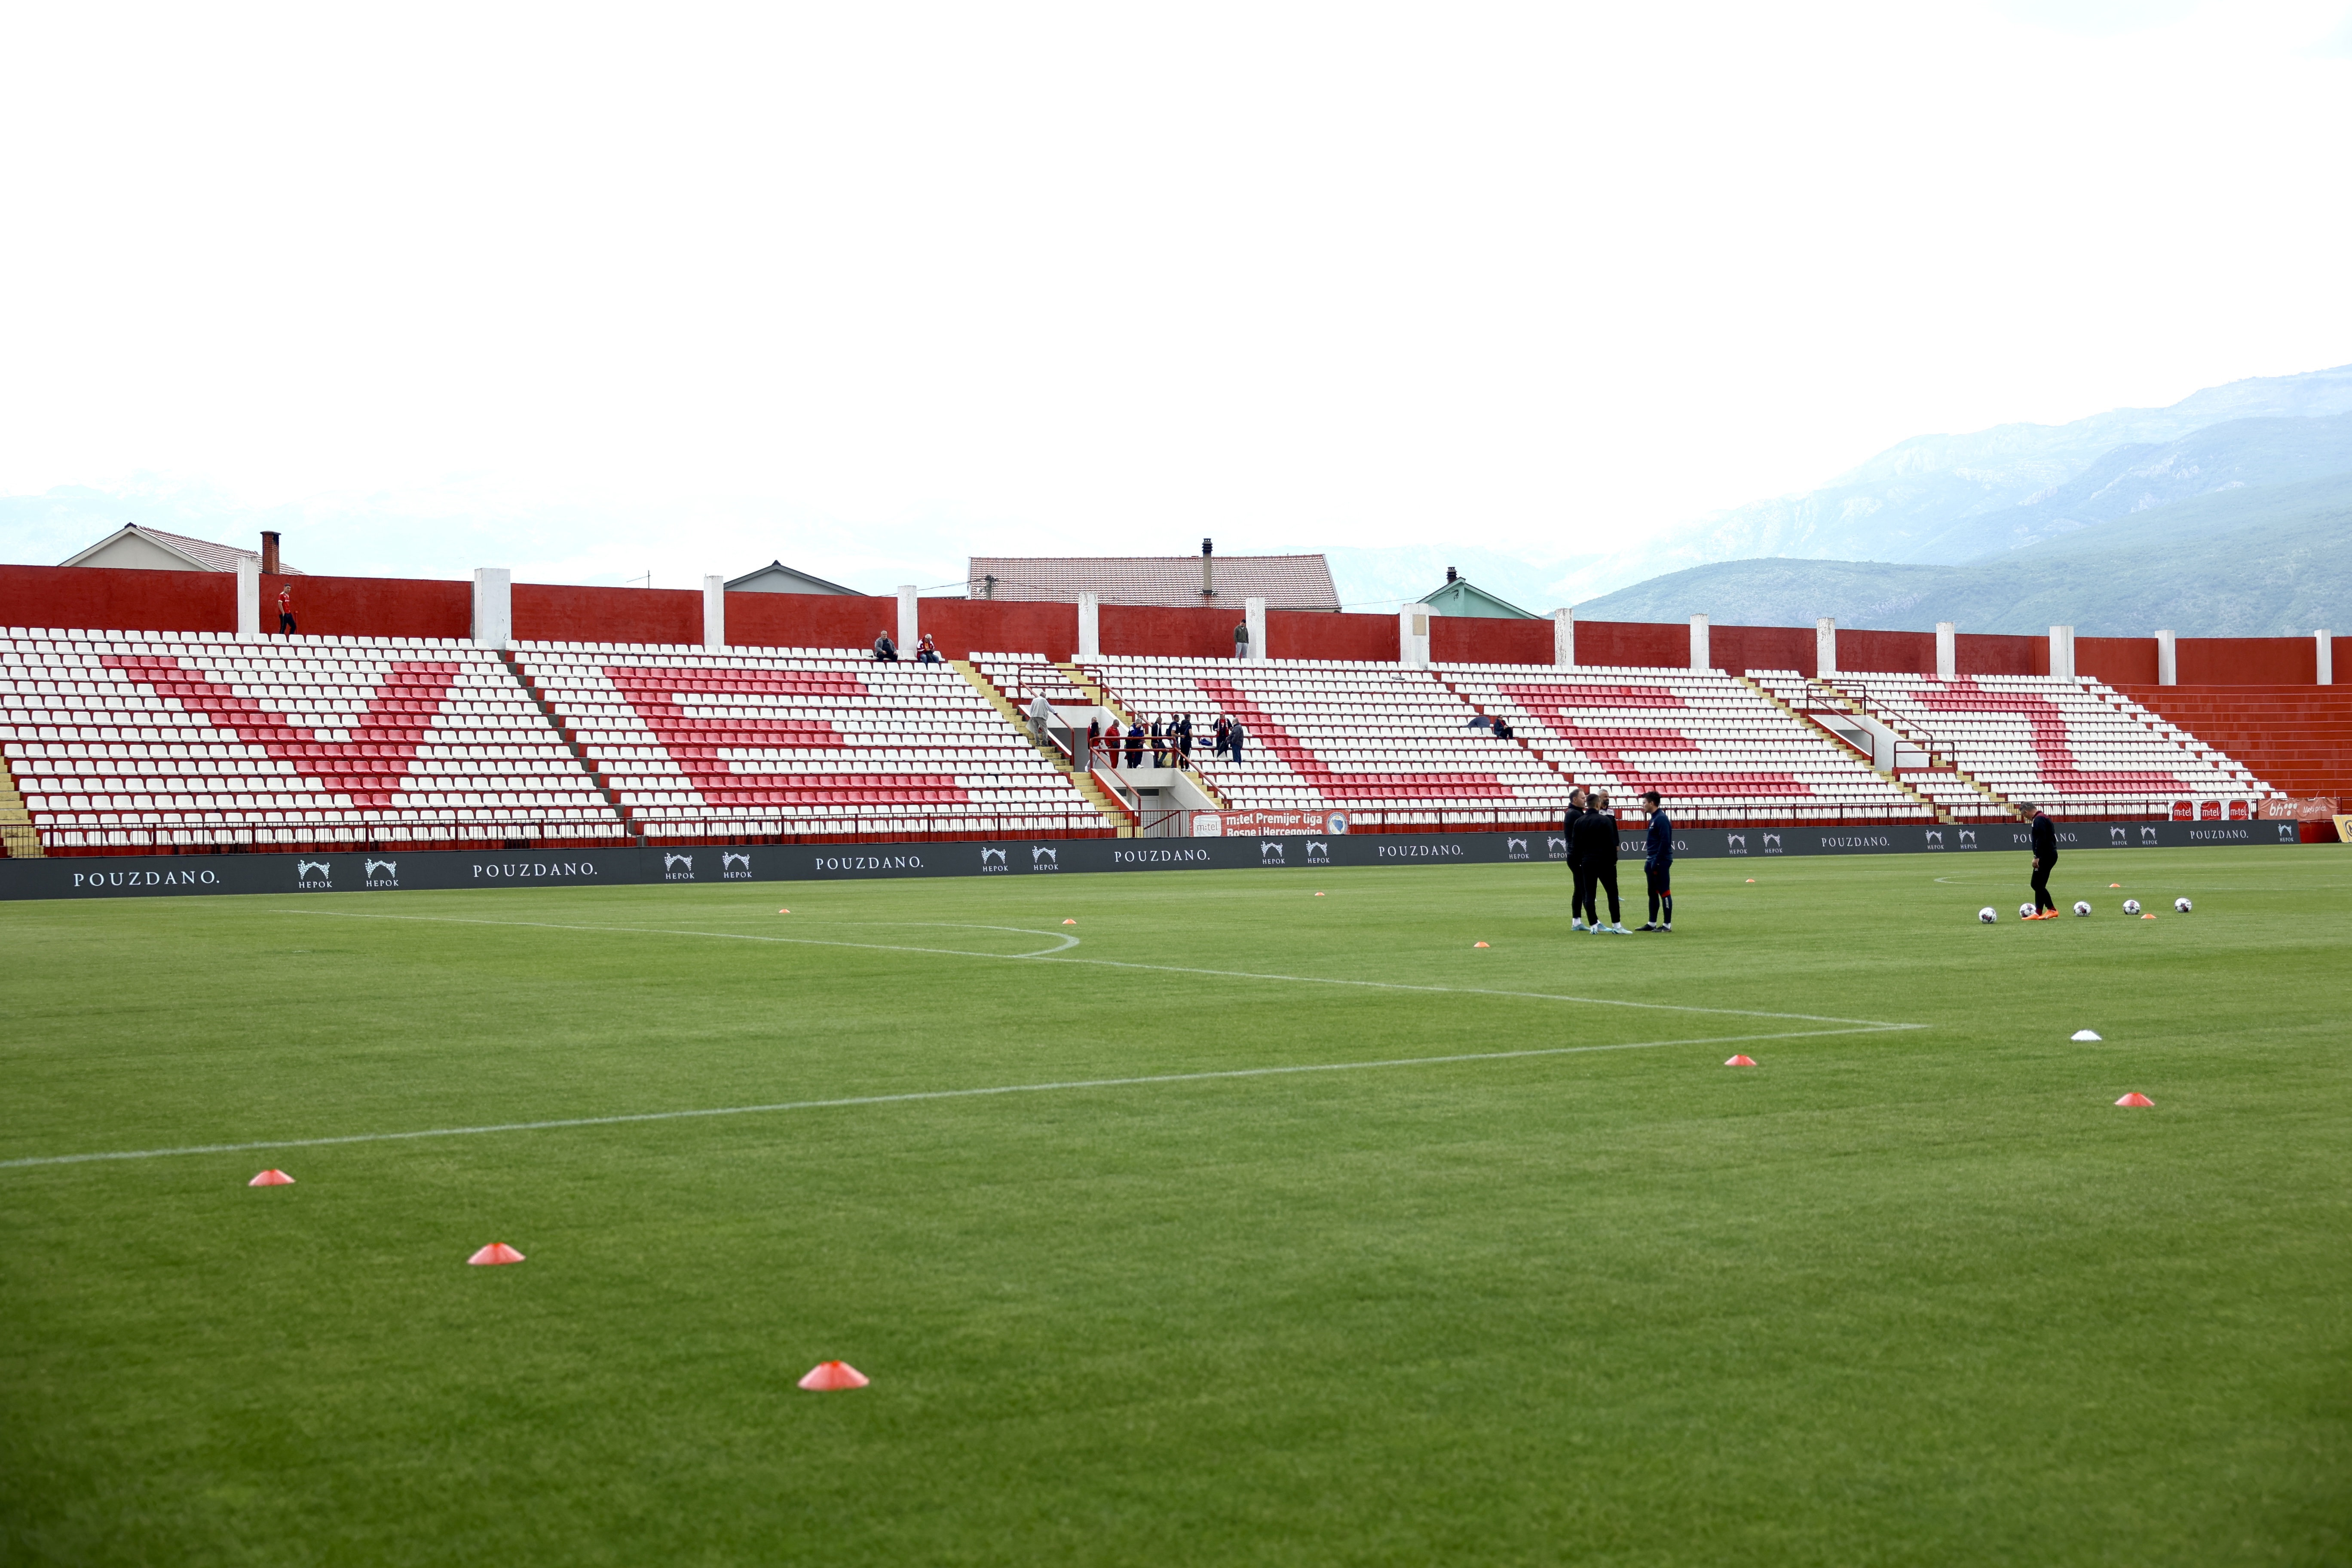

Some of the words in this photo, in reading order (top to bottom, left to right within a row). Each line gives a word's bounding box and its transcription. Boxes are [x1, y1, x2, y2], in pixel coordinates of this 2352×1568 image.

[2174, 808, 2191, 817] m:tel
[2202, 807, 2219, 816] m:tel
[2230, 806, 2246, 816] m:tel
[1226, 814, 1254, 825] m:tel
[1256, 813, 1301, 826] Premijer
[1303, 813, 1322, 826] liga
[1197, 822, 1217, 831] m:tel
[1227, 828, 1256, 836] Bosne
[1258, 827, 1262, 836] i
[2190, 830, 2248, 839] POUZDANO.
[1620, 840, 1689, 851] OUZNO.
[1822, 837, 1889, 846] POUZDANO.
[1378, 845, 1463, 856] POUZDANO.
[1115, 850, 1210, 862] POUZDANO.
[816, 857, 923, 869] POUZDANO.
[473, 863, 597, 877] POUZDANO.
[74, 871, 219, 886] POUZDANO.
